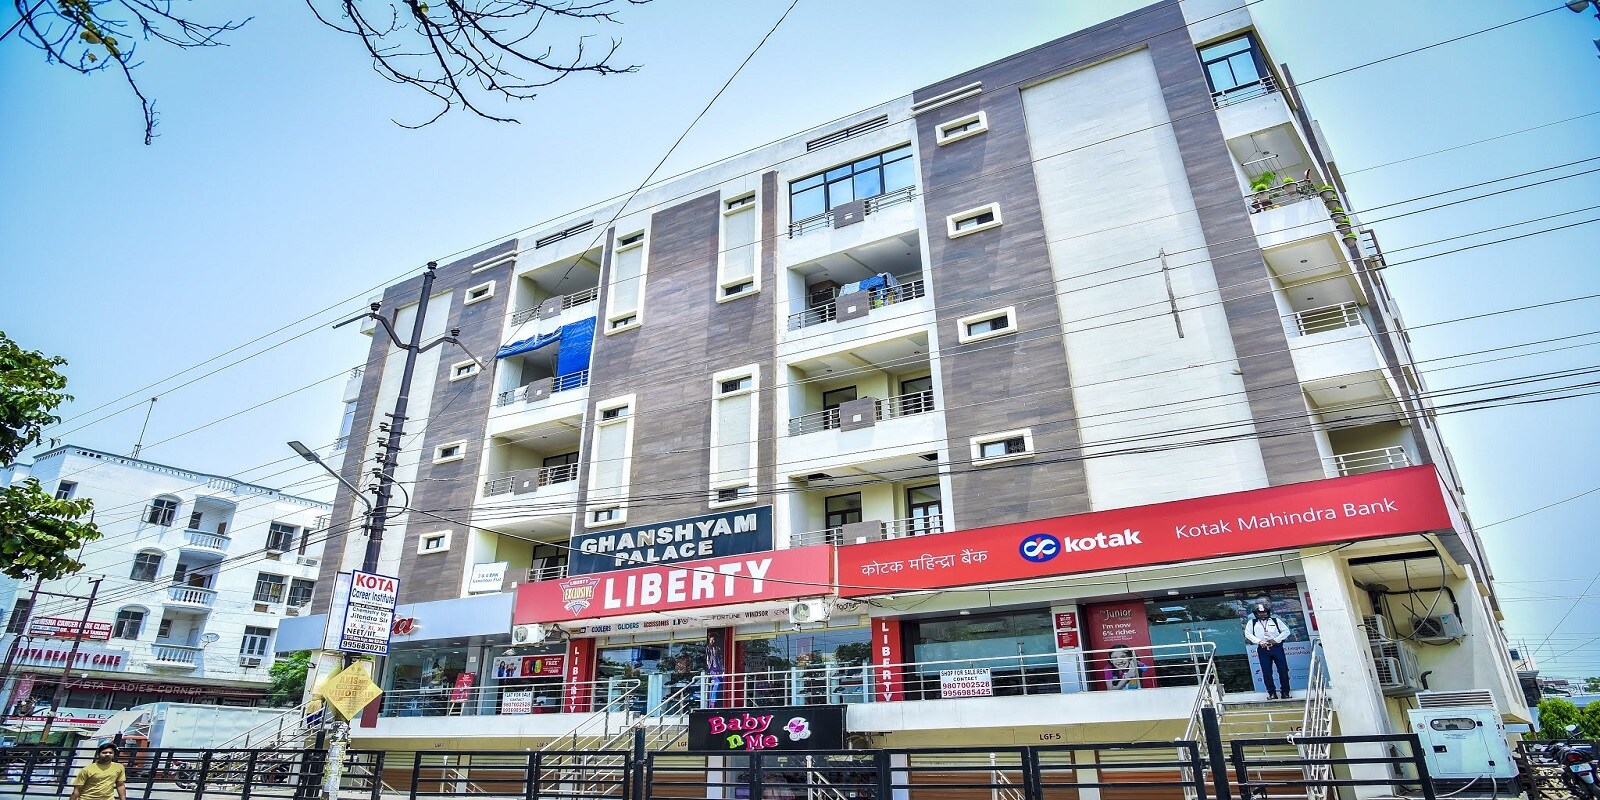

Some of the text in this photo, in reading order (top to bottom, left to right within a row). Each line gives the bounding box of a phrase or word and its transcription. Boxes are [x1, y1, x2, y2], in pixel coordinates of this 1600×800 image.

[1175, 497, 1398, 539] Kotak Mahindra Bank
[580, 513, 757, 555] GHANSHYAM
[1064, 528, 1143, 553] kotak
[614, 540, 714, 567] PALACE
[861, 548, 989, 576] कोटक महिन्द्रा बैंक
[355, 573, 394, 593] KOTA
[604, 558, 773, 609] LIBERTY
[351, 588, 372, 600] Career
[371, 591, 395, 604] Institute
[565, 585, 593, 600] EXCLUSIVE
[350, 613, 378, 622] Jitendra
[352, 607, 380, 616] Chemistry
[744, 610, 769, 618] WINDSOR
[1105, 609, 1132, 620] Junior
[591, 625, 612, 633] COOLERS
[617, 622, 640, 630] GLIDERS
[342, 640, 386, 652] 9956830216
[44, 649, 91, 664] BEATY
[92, 654, 122, 666] CARE
[881, 622, 892, 702] LIBERTY
[569, 646, 580, 713] LIBERTY
[942, 681, 990, 689] 9807002528
[112, 682, 153, 692] LADIES
[157, 685, 202, 695] CORNER
[942, 688, 991, 696] 9956985425
[708, 712, 774, 738] Baby
[726, 733, 779, 750] n Me
[1039, 732, 1062, 741] LGF-5
